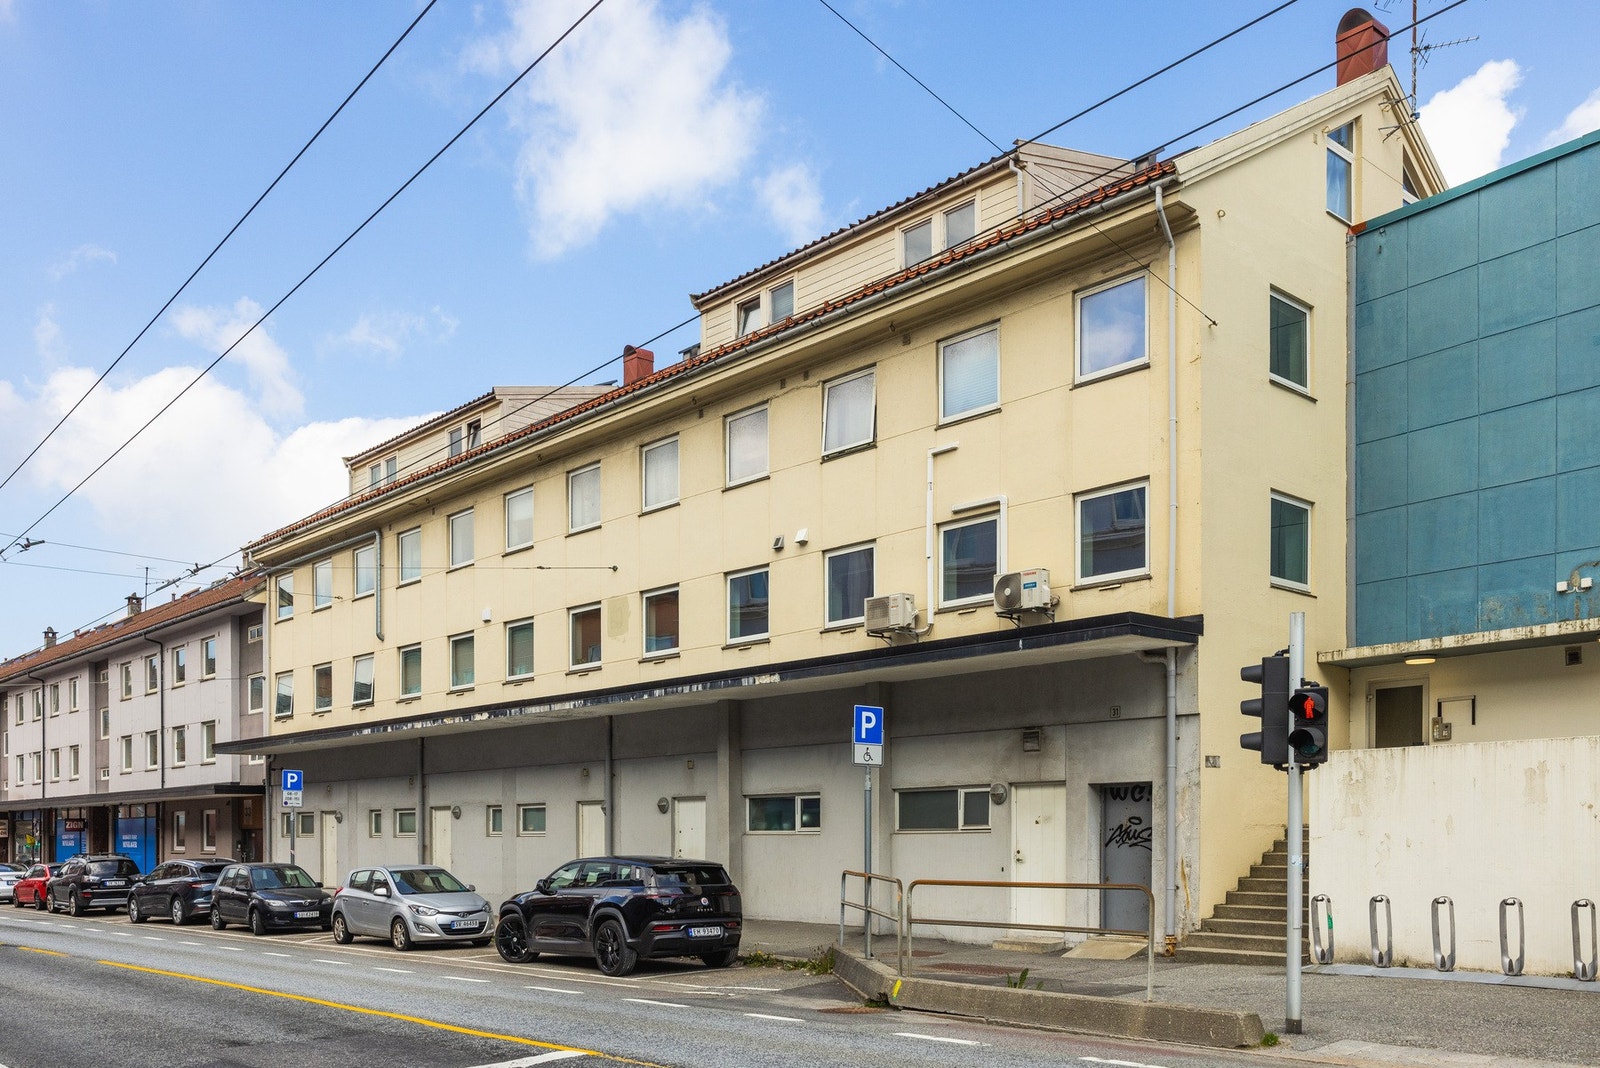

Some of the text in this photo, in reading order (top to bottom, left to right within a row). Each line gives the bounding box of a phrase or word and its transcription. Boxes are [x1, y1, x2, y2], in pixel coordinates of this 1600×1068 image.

[1112, 708, 1119, 716] 31
[861, 711, 876, 739] P
[287, 772, 298, 788] P
[65, 821, 84, 829] ZIGN
